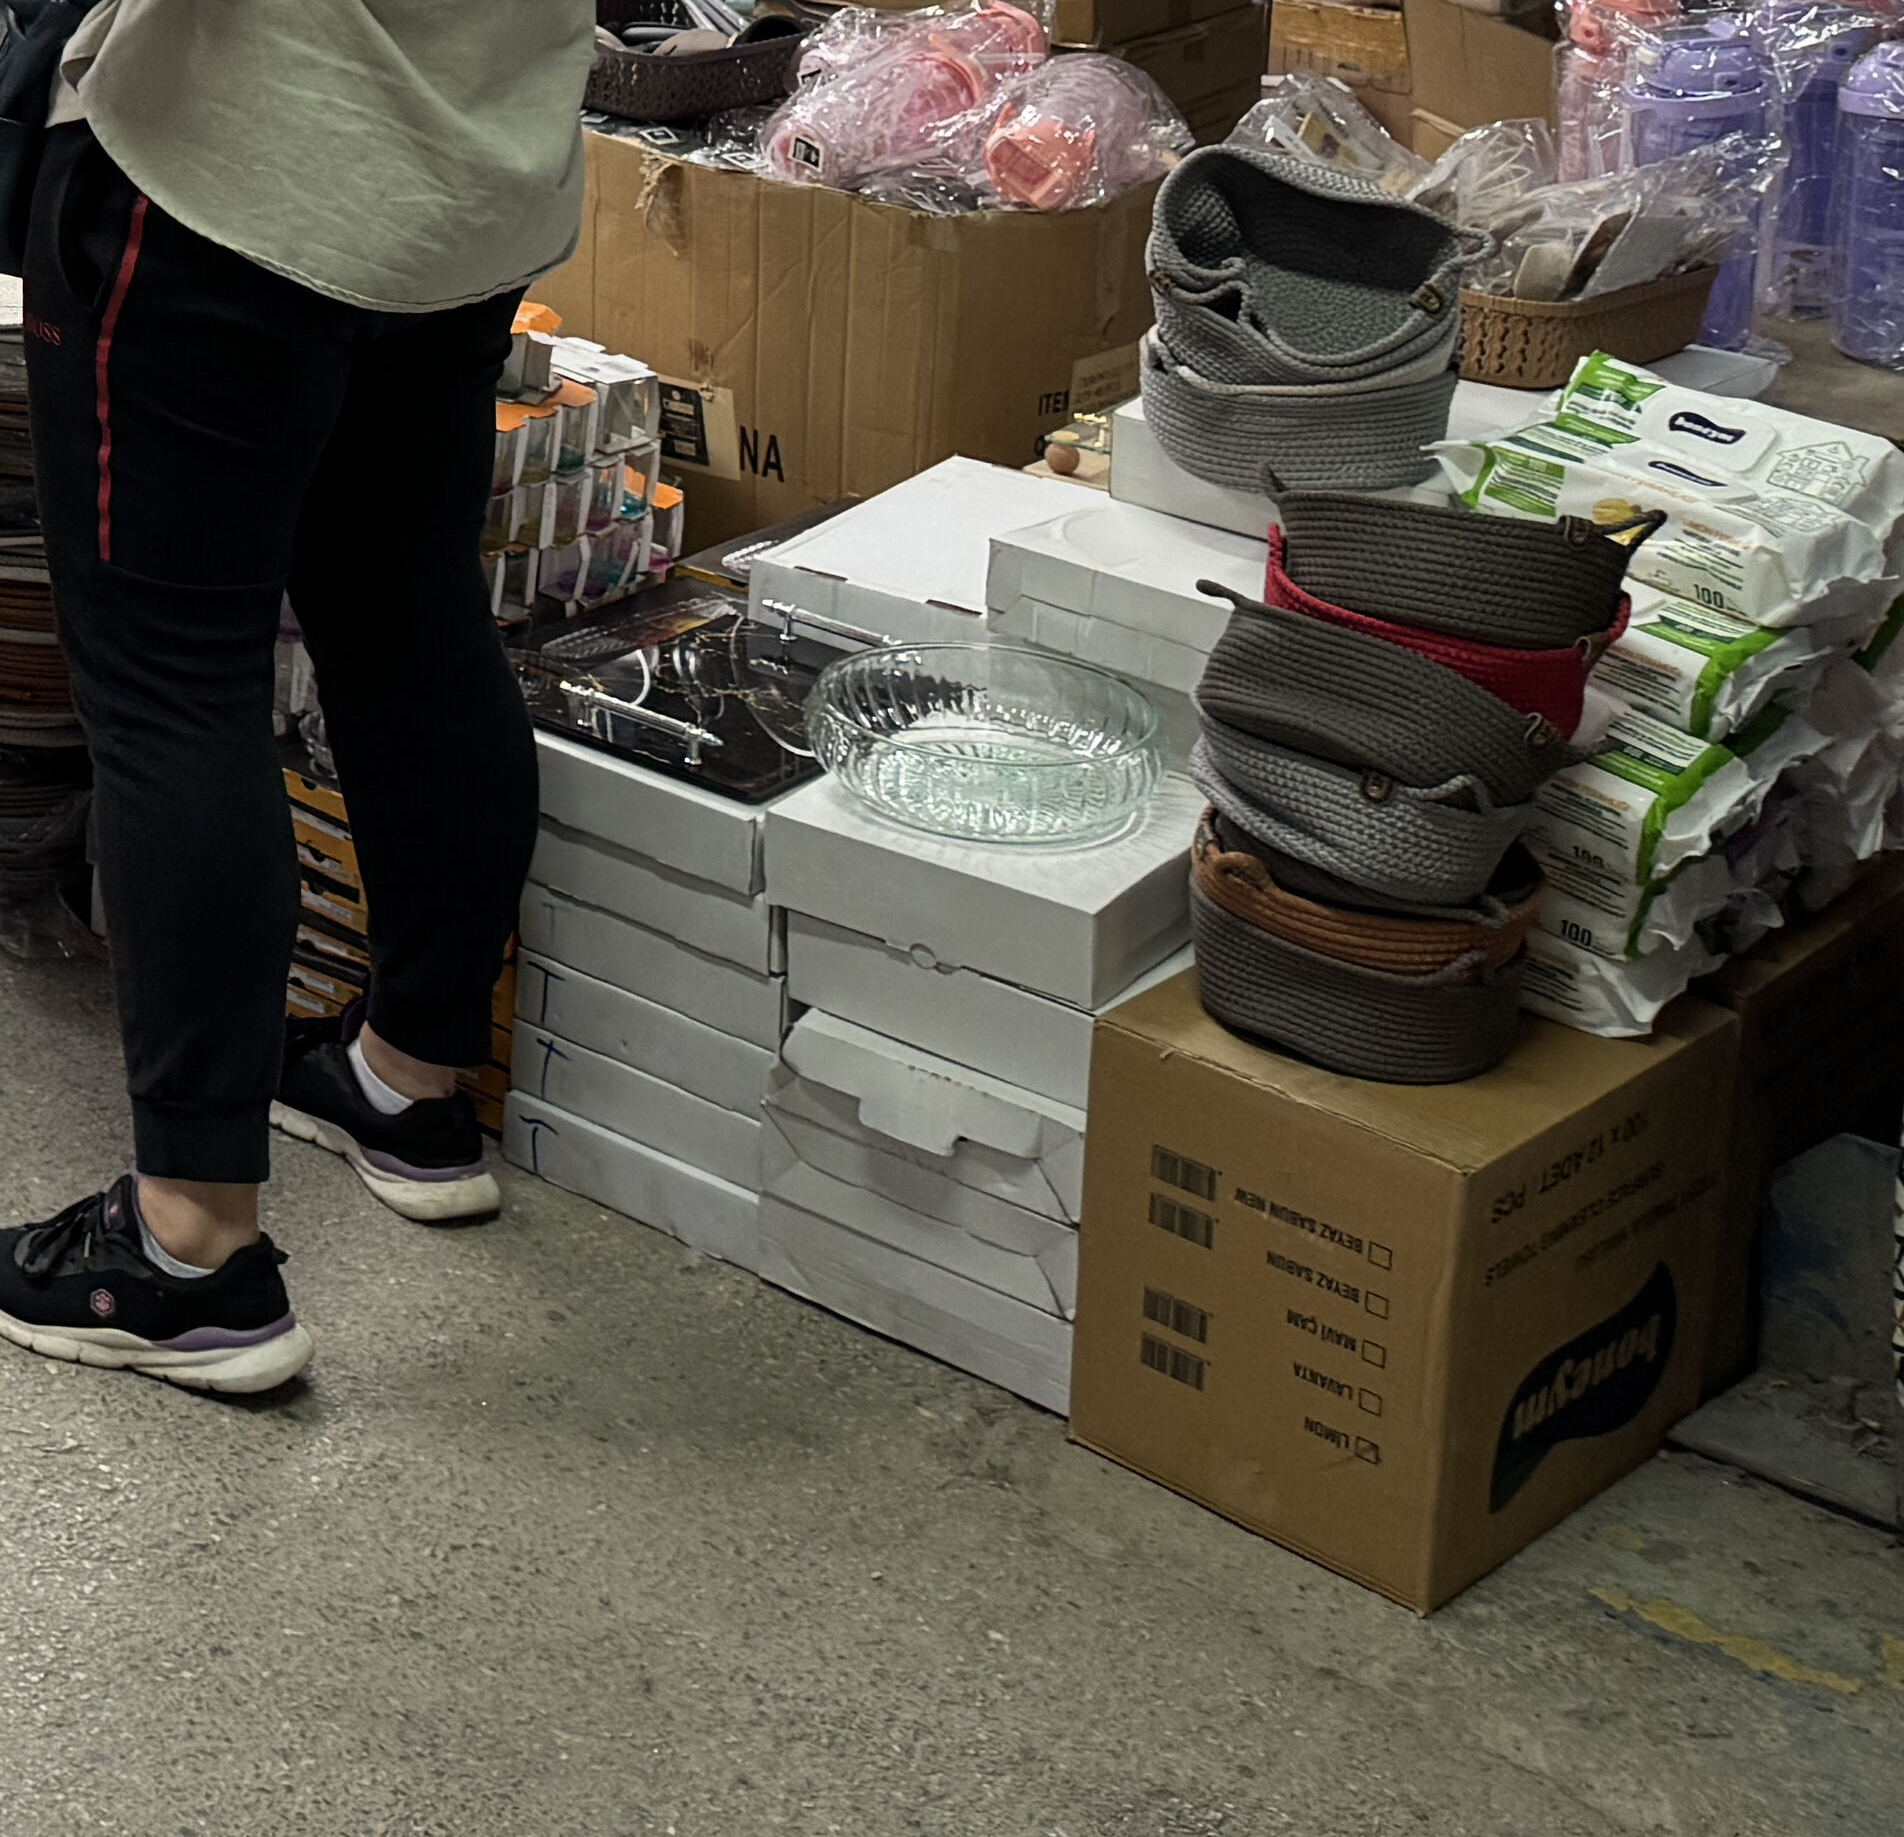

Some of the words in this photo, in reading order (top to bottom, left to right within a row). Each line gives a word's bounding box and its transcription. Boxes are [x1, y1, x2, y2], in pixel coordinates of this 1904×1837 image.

[1693, 583, 1725, 610] 100
[1559, 919, 1593, 947] 100
[1538, 1151, 1584, 1196] ADET
[1269, 1202, 1318, 1235] SABUN
[1490, 1181, 1527, 1225] PCS
[1319, 1222, 1363, 1254] BEYAZ
[1267, 1250, 1314, 1283] SABUN
[1317, 1273, 1360, 1304] BEYAZ
[1286, 1308, 1318, 1336] ÇAM
[1320, 1324, 1357, 1352] MAVİ
[1292, 1360, 1353, 1401] LAVANTA
[1304, 1416, 1350, 1450] LİMON
